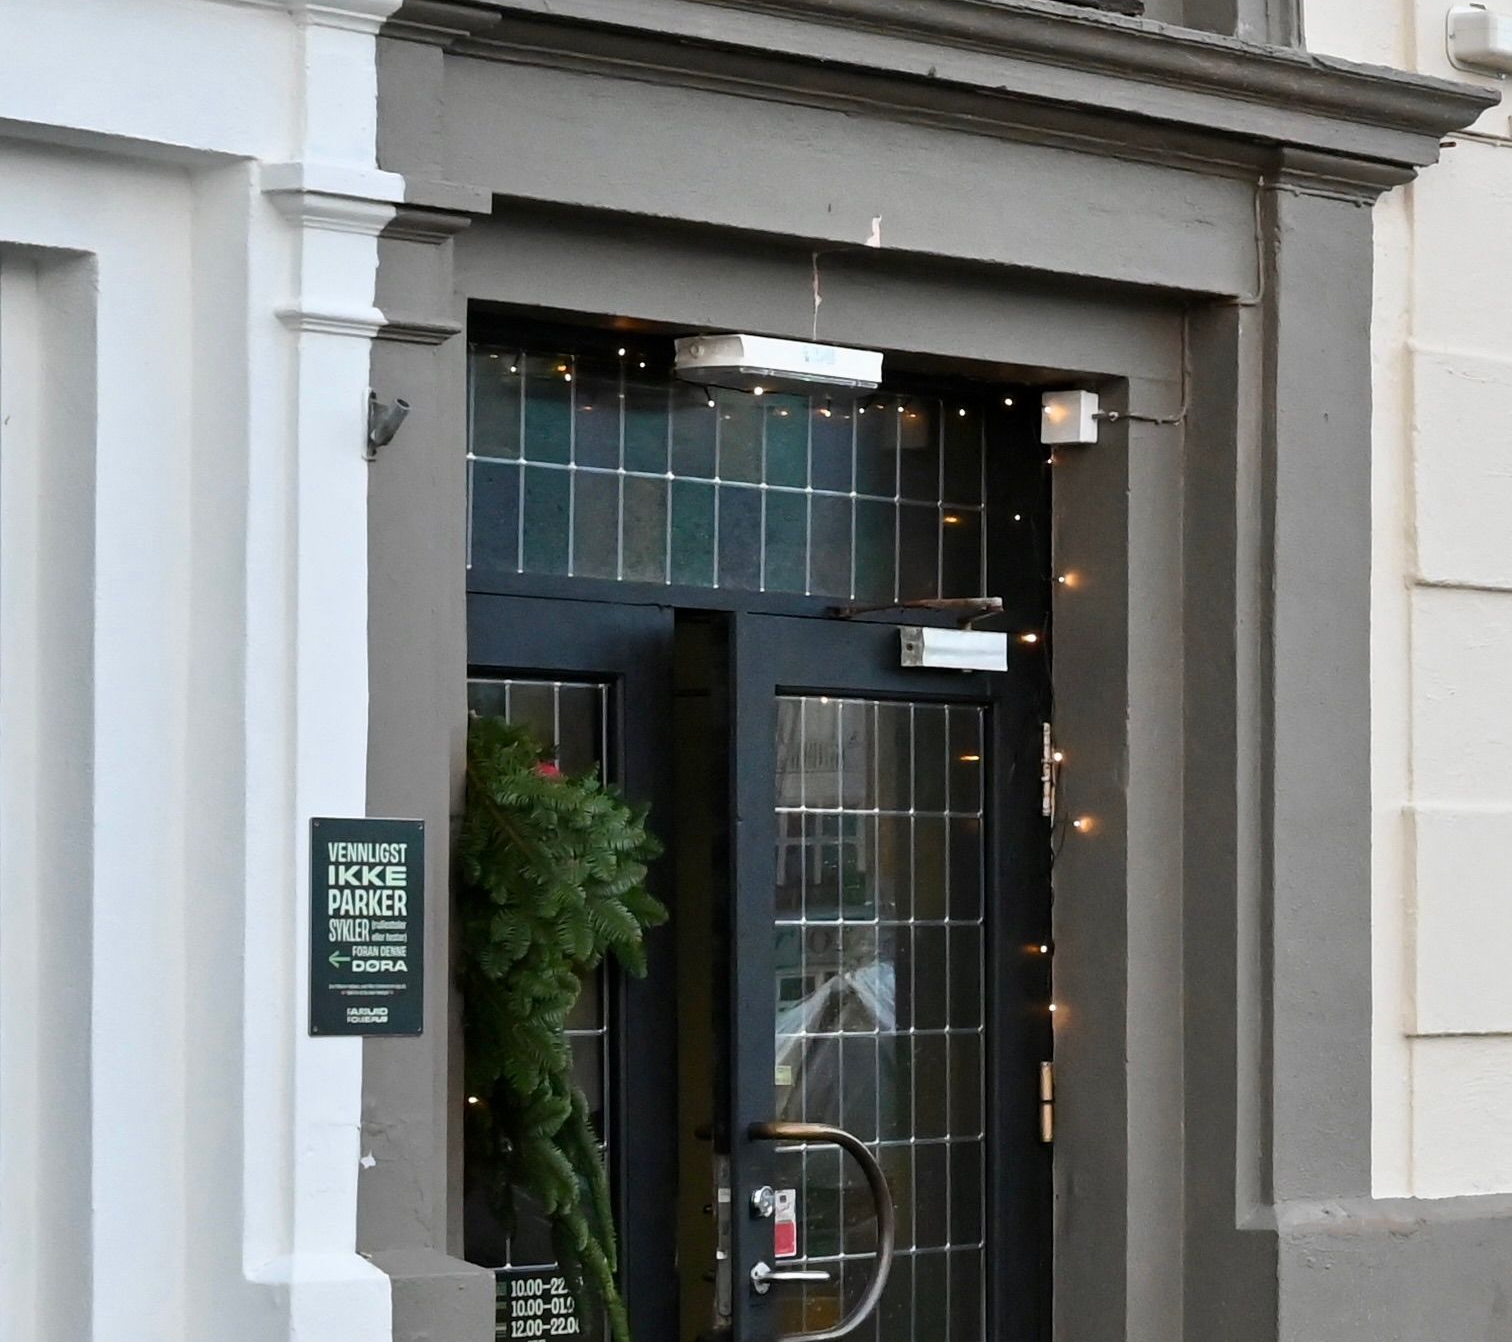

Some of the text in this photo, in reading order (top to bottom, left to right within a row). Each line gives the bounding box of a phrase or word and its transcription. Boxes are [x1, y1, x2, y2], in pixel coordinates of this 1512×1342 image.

[328, 842, 408, 863] VENNLIGST
[328, 865, 408, 887] IKKE
[328, 889, 408, 916] PARKER
[329, 918, 370, 942] SYKLER
[352, 960, 408, 972] DØRA
[511, 1277, 569, 1297] 10.00-22
[511, 1296, 575, 1317] 10.00-01.0
